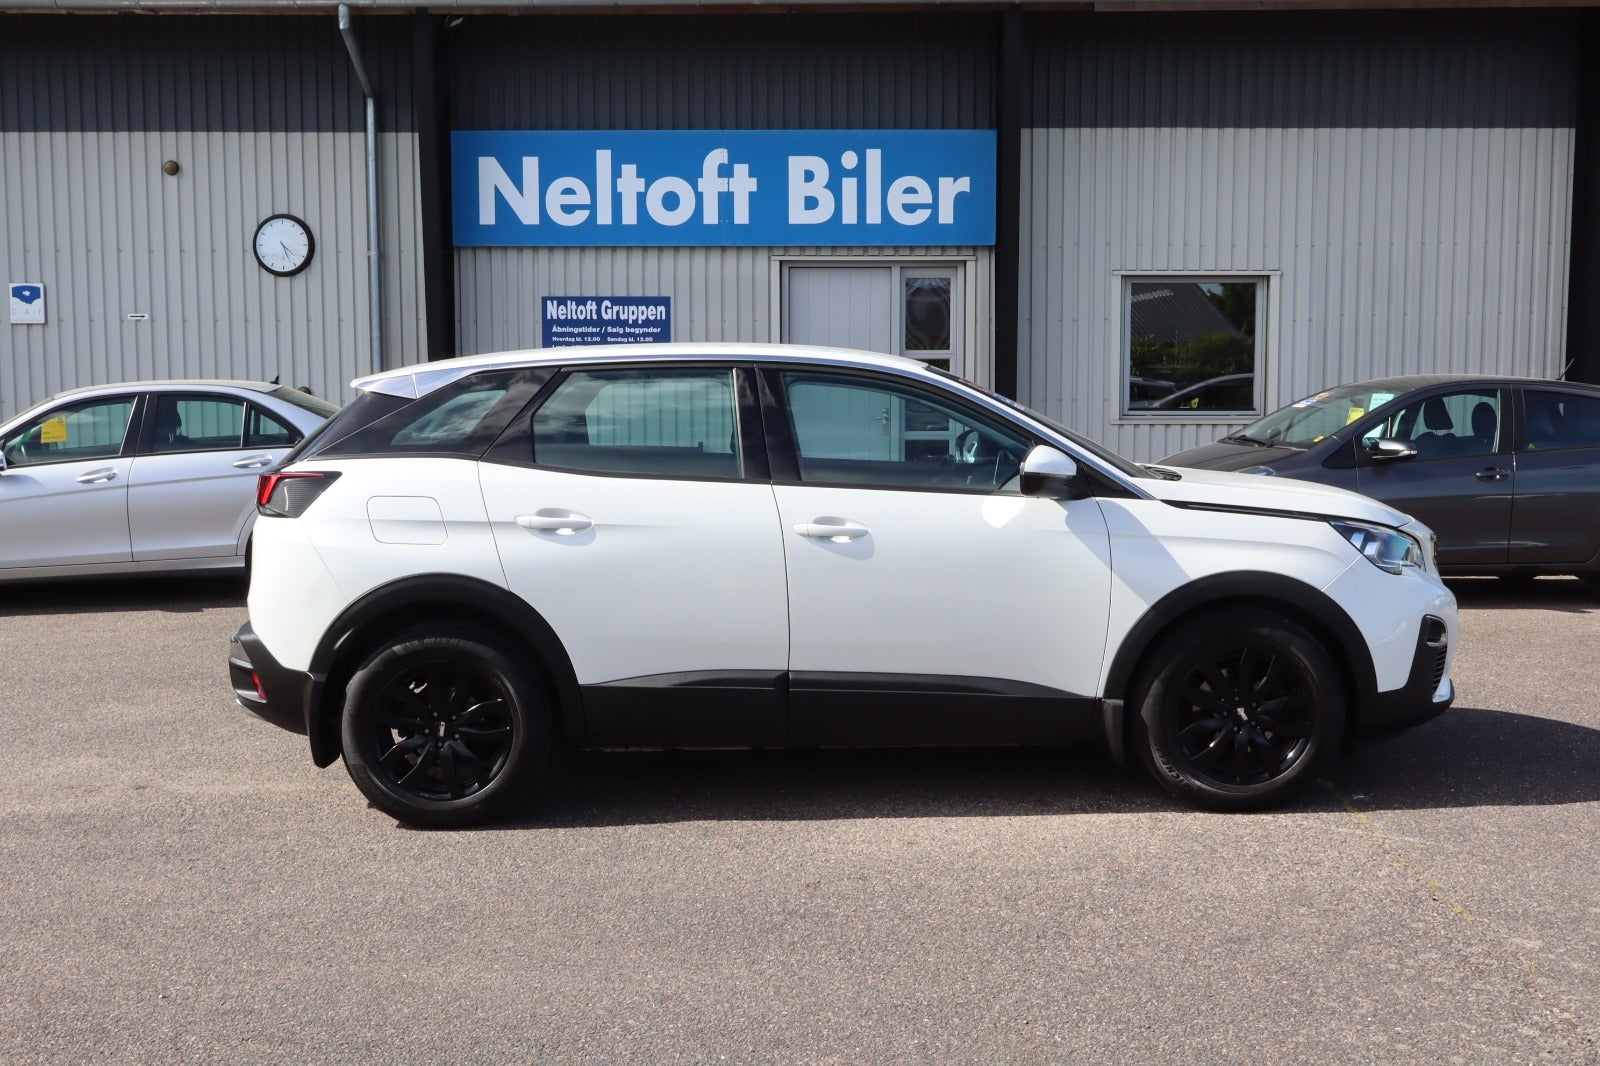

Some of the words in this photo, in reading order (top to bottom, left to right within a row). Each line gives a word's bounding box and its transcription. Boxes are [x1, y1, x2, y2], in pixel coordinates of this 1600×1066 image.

[477, 148, 758, 227] Neltoft
[787, 148, 971, 227] Biler
[546, 300, 597, 320] Neltoft
[601, 299, 666, 324] Gruppen
[552, 324, 600, 334] Åbningstider
[606, 326, 624, 334] Salg
[625, 326, 661, 334] begynder
